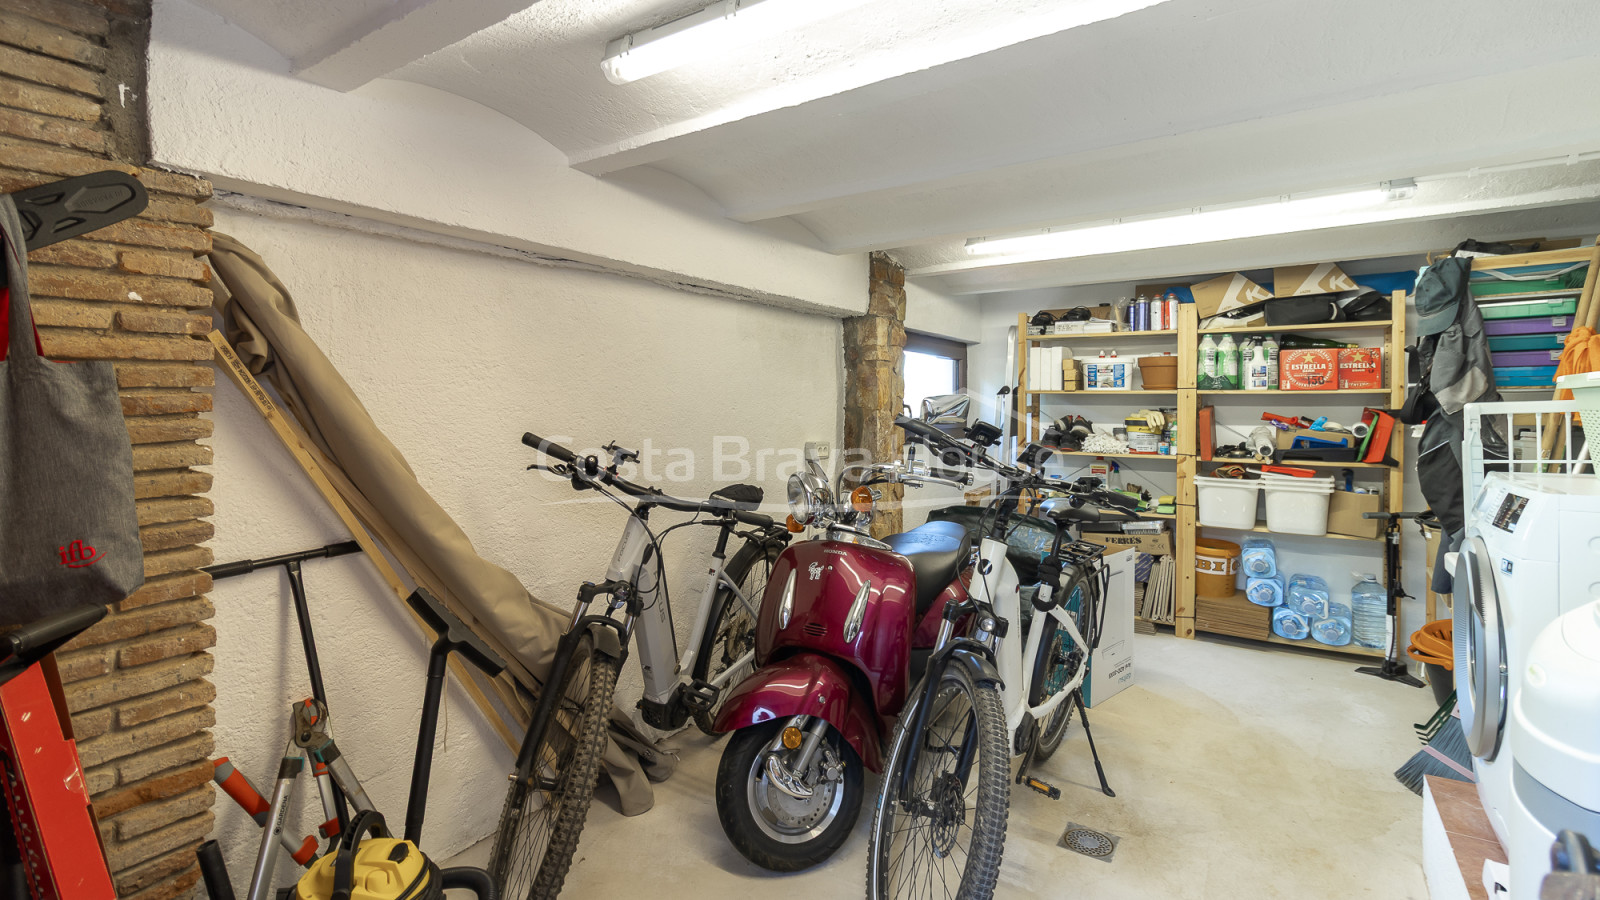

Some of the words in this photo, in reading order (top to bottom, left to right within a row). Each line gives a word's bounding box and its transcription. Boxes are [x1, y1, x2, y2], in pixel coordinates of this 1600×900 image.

[1291, 362, 1326, 370] ESTRELLA
[59, 540, 97, 565] ifb
[618, 531, 631, 562] FOCUS
[653, 569, 666, 624] FCUS
[276, 795, 289, 826] GARDENA
